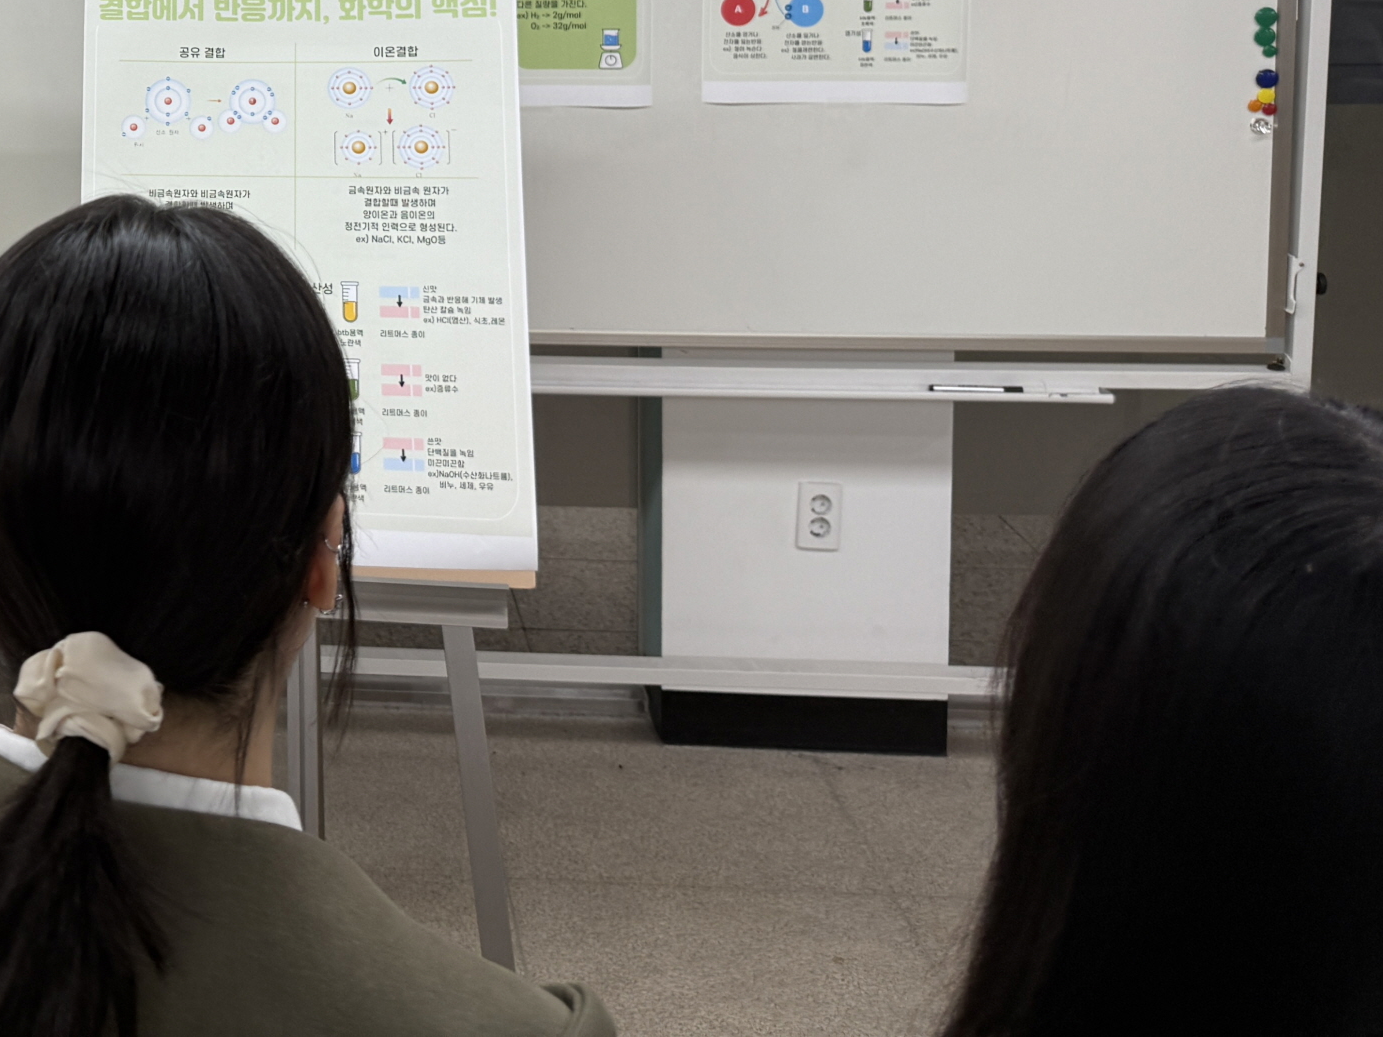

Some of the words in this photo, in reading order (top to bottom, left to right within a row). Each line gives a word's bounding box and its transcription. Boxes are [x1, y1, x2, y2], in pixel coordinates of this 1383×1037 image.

[180, 47, 200, 58] 공유
[205, 47, 225, 58] 결합
[374, 46, 418, 57] 이온결합
[349, 186, 391, 195] 금속원자와
[394, 186, 419, 195] 비금속
[424, 187, 449, 195] 원자가
[365, 198, 398, 207] 결합할때
[402, 199, 435, 207] 발생하며
[363, 210, 397, 219] 양이온과
[401, 211, 434, 219] 음이온의
[345, 222, 378, 231] 정전기적
[382, 223, 416, 231] 인력으로
[420, 223, 457, 232] 형성된다.
